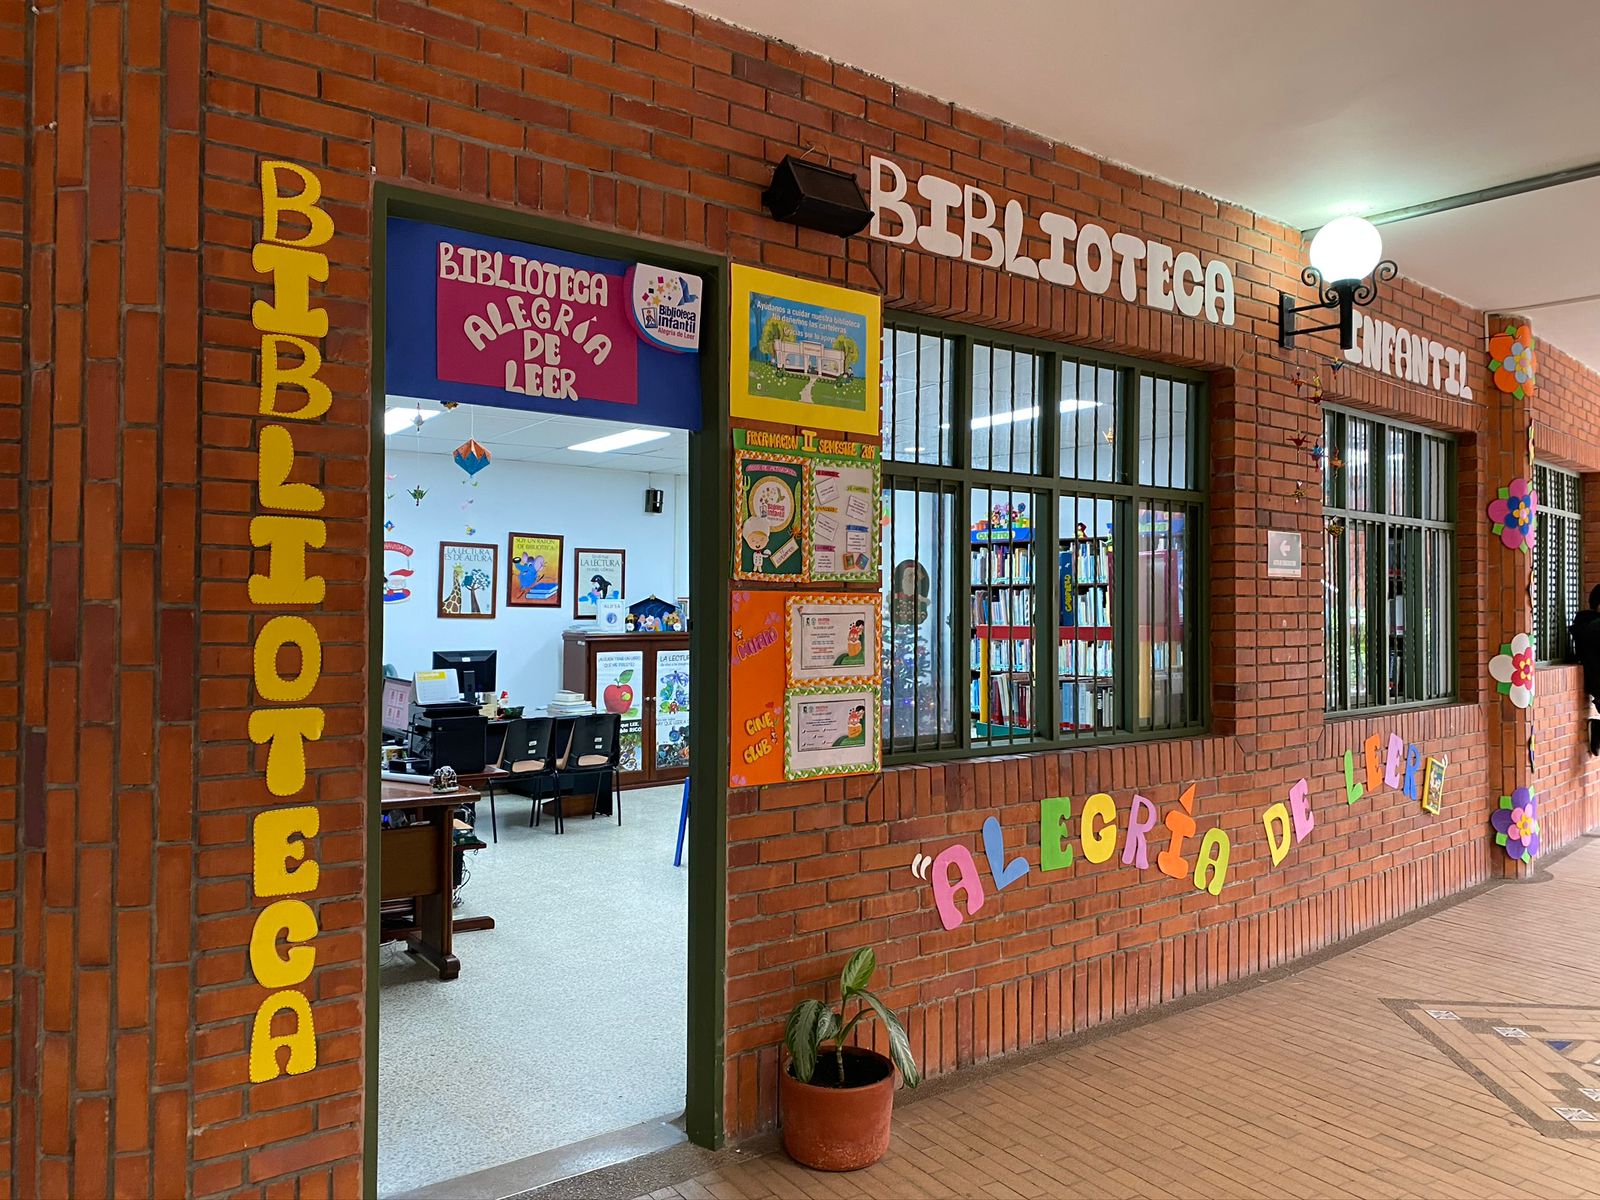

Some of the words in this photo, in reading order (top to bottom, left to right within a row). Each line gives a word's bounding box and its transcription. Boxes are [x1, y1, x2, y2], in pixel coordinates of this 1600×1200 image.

[439, 242, 608, 307] BIBLIOTECA
[869, 154, 1235, 326] BIBLIOTECA
[1343, 308, 1474, 400] INFANTIL
[658, 315, 697, 334] Infantil
[659, 305, 697, 321] Biblioteca
[523, 329, 561, 366] DE
[505, 360, 579, 401] LEER
[580, 559, 590, 567] LA
[590, 559, 621, 567] LECTURA
[248, 160, 335, 1084] BIBLIOTECA
[745, 711, 774, 736] CINE
[743, 738, 773, 765] CLUB
[1262, 777, 1315, 867] DE
